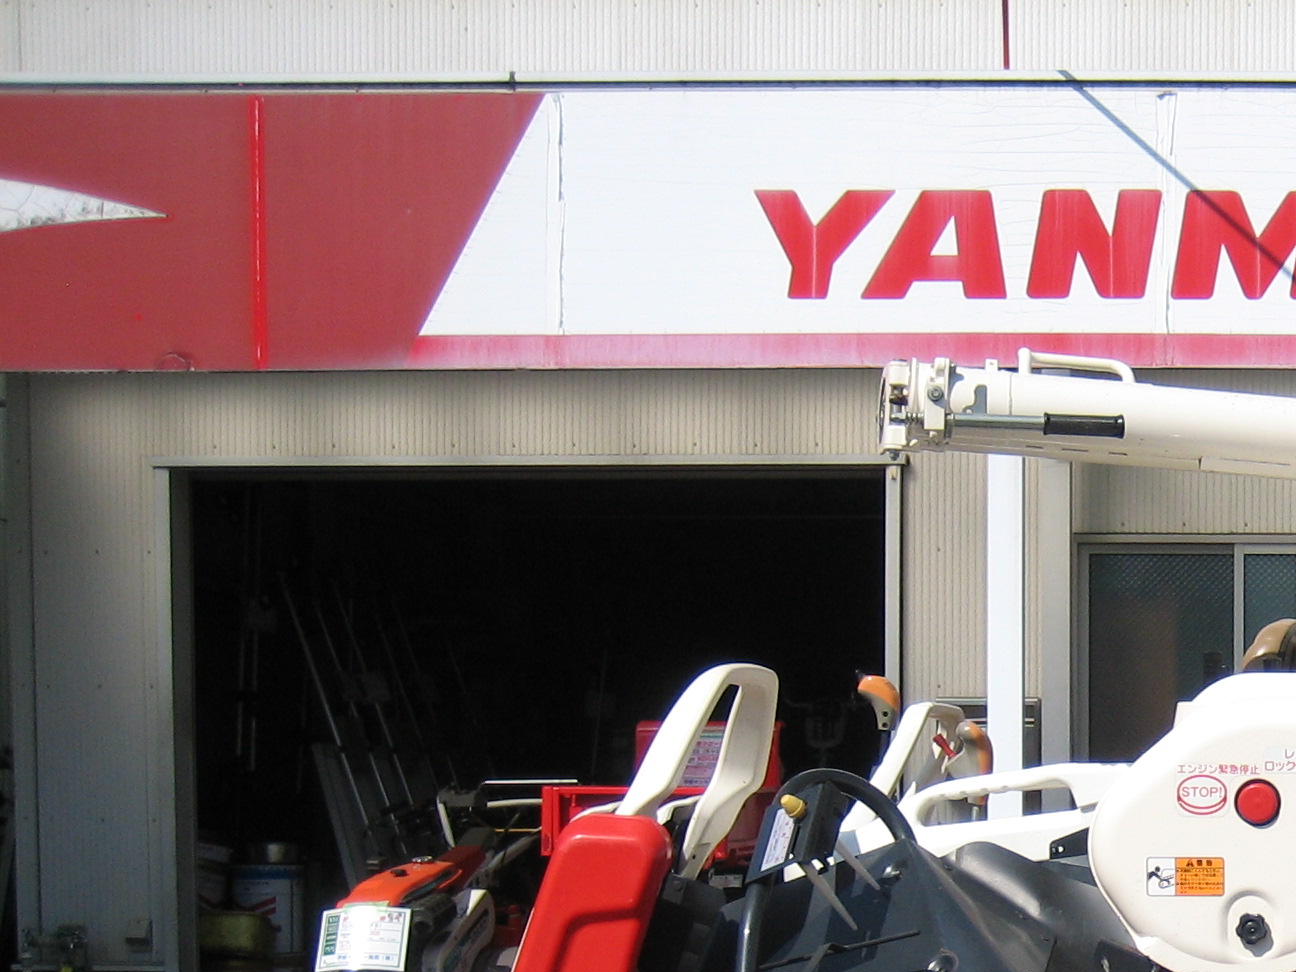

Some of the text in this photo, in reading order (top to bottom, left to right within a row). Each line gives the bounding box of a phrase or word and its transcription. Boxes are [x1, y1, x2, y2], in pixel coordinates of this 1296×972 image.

[1177, 764, 1260, 775] エンジン緊急停止
[1181, 786, 1223, 799] STOP!
